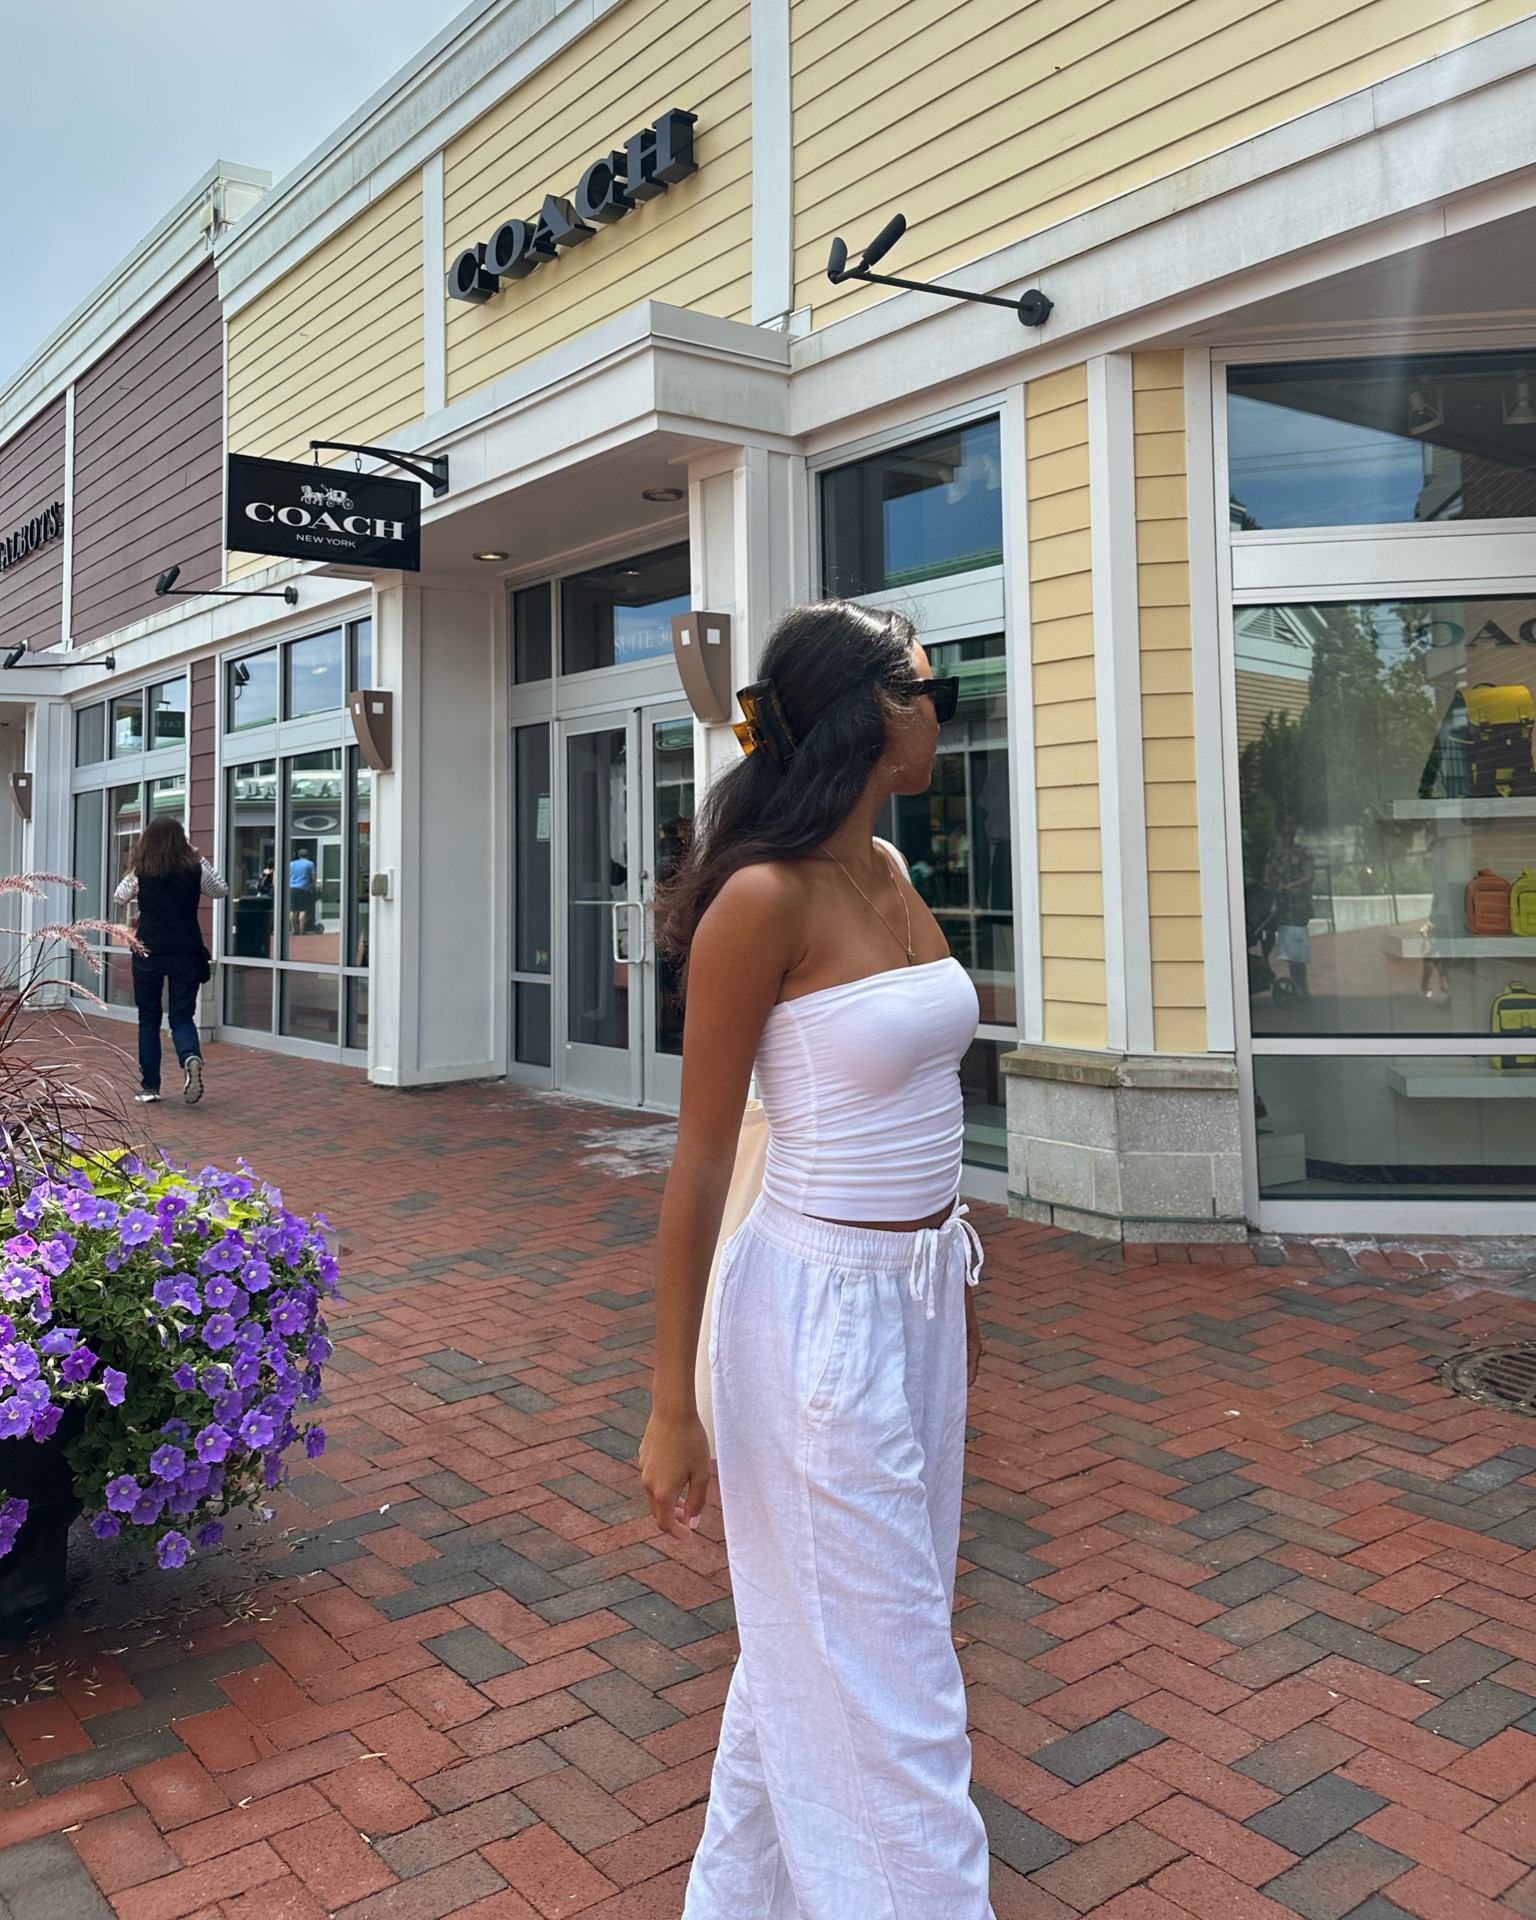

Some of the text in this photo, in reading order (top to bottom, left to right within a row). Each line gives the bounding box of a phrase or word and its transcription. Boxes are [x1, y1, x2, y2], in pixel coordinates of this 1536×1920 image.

[448, 108, 698, 304] COACH
[0, 502, 59, 572] ALBOTS
[245, 502, 405, 541] COACH
[296, 534, 356, 549] NEW YORK
[614, 628, 654, 655] SUITE
